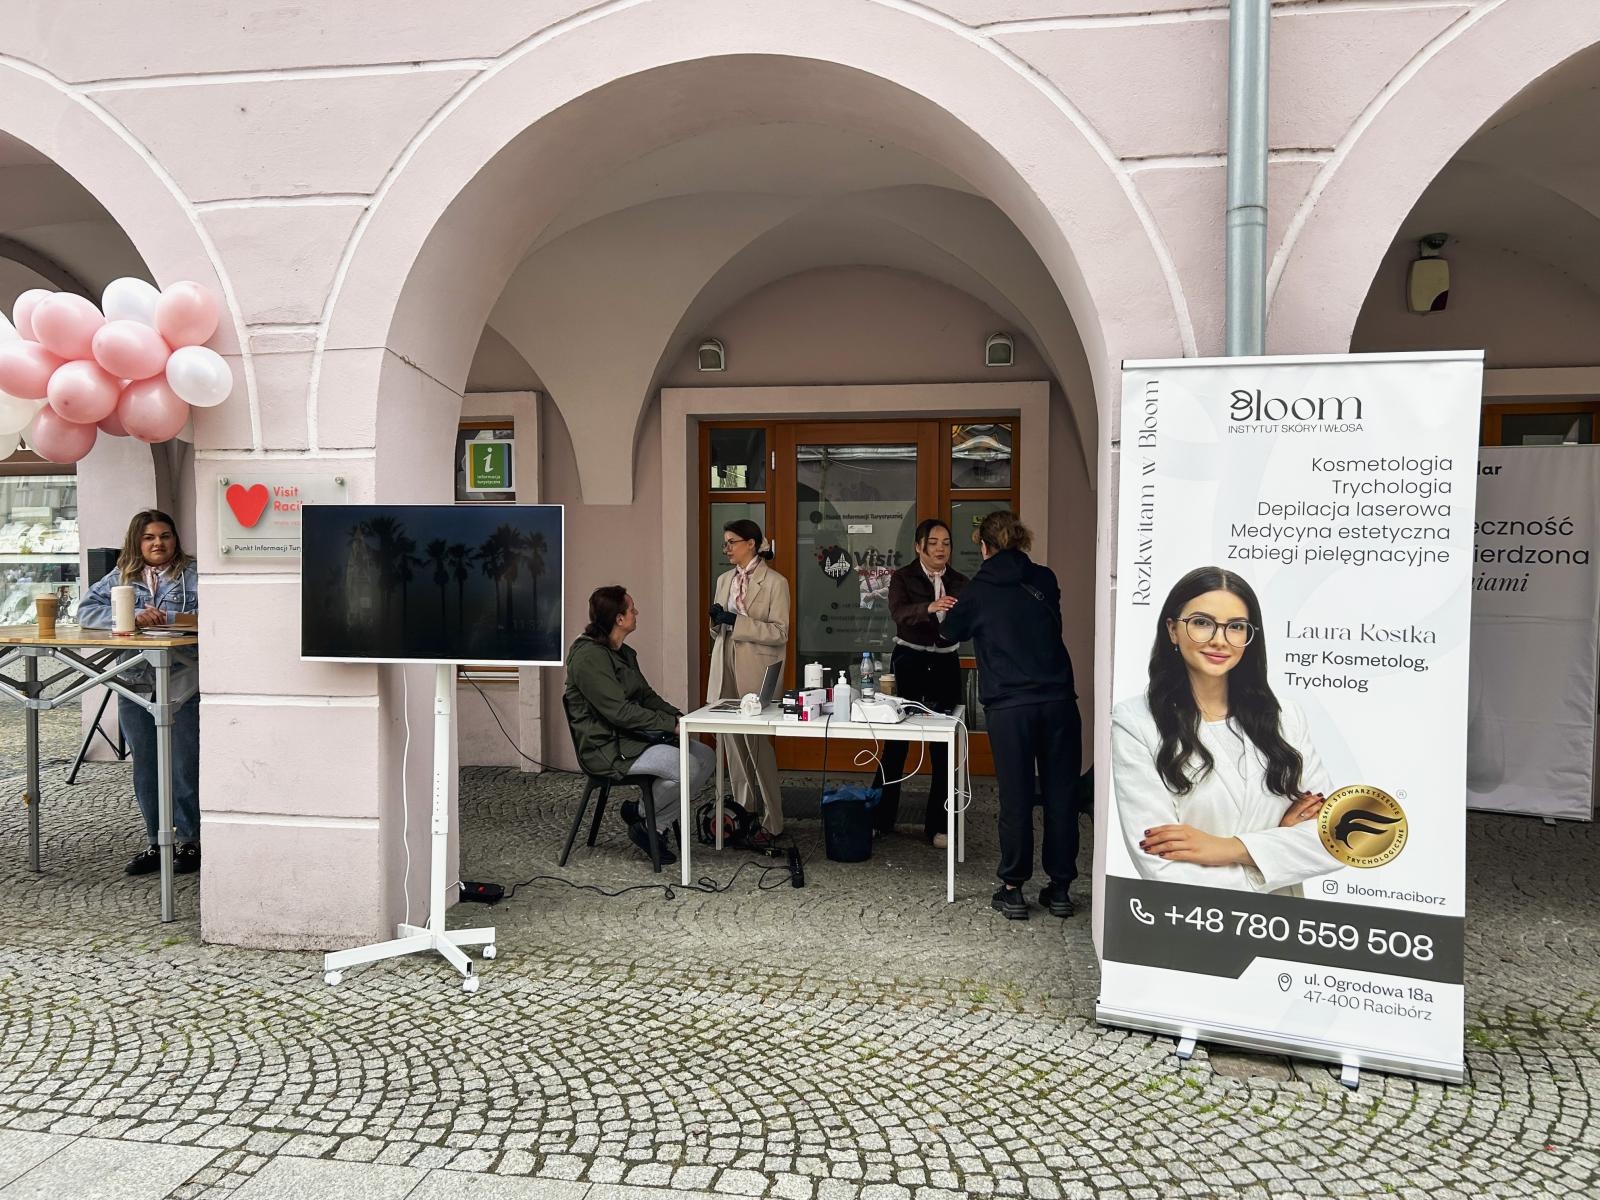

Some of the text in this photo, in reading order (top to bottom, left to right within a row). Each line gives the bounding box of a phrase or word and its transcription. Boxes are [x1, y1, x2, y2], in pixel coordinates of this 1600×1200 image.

[1230, 389, 1362, 421] Bloom
[1228, 424, 1279, 434] INSTYTUT
[1324, 423, 1363, 433] WŁOSA
[1312, 456, 1453, 475] Kosmetologia
[1477, 461, 1502, 475] lar
[273, 486, 298, 497] Visit
[1131, 381, 1159, 605] Rozkwitam w Bloom
[1332, 479, 1451, 498] Trychologia
[273, 500, 303, 511] Raci
[1258, 502, 1451, 521] Depilacja laserowa
[1231, 524, 1450, 543] Medycyna estetyczna
[1474, 516, 1574, 535] czność
[254, 545, 287, 553] Informacji
[854, 549, 903, 566] Visit
[1228, 545, 1449, 567] Zabiegi pielęgnacyjne
[1474, 544, 1589, 564] ierdzona
[1472, 572, 1529, 592] iami
[1286, 621, 1437, 644] Laura Kostka
[1285, 651, 1428, 672] mgr Kosmetolog,
[1285, 672, 1368, 693] Trycholog
[1321, 803, 1333, 835] POLSKIE
[1346, 828, 1405, 865] TRYCHOLOGICZNE
[1346, 883, 1446, 906] bloom.raciborz
[1164, 905, 1434, 961] +48 780 559 508
[1304, 973, 1433, 1003] ul. Ogrodowa 18a
[1303, 990, 1433, 1021] 47-400 Racibórz
